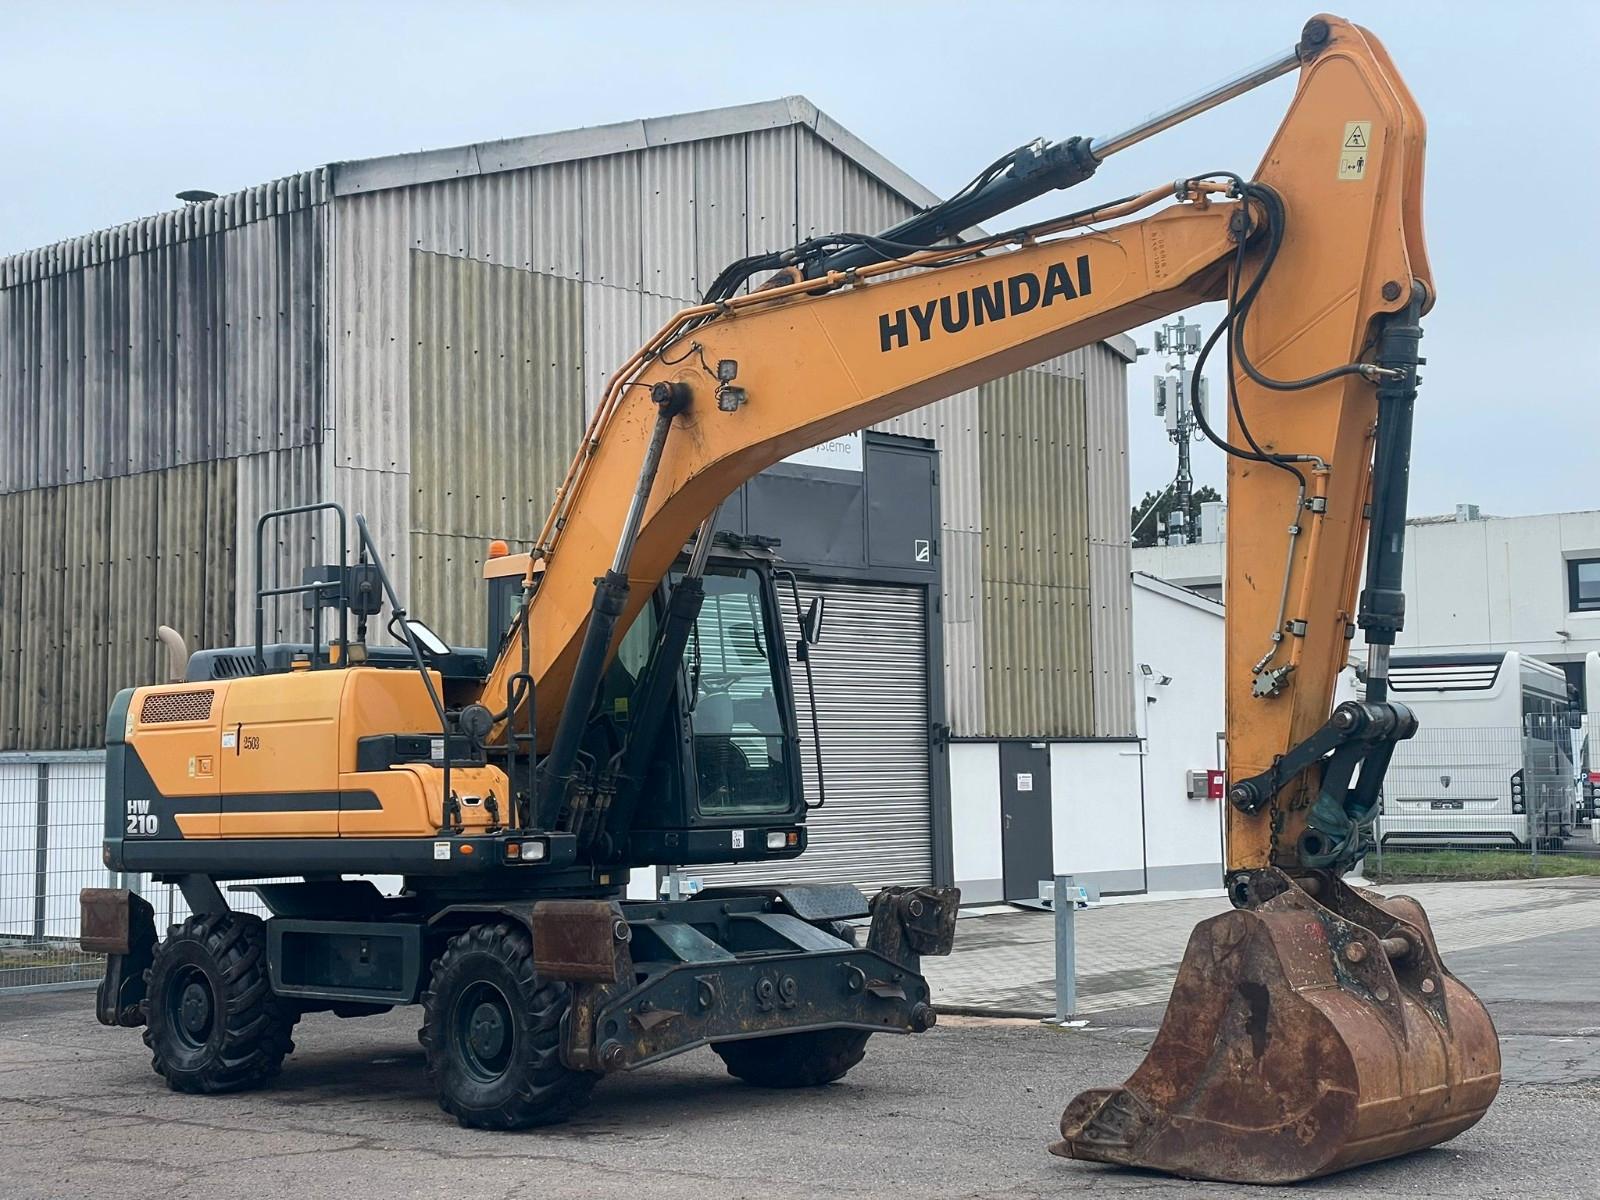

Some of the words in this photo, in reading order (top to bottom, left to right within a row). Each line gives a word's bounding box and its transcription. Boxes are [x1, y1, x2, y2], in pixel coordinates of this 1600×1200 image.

[879, 255, 1091, 352] HYUNDAI
[811, 440, 852, 454] ysteme
[127, 799, 150, 814] HW
[126, 814, 159, 836] 210
